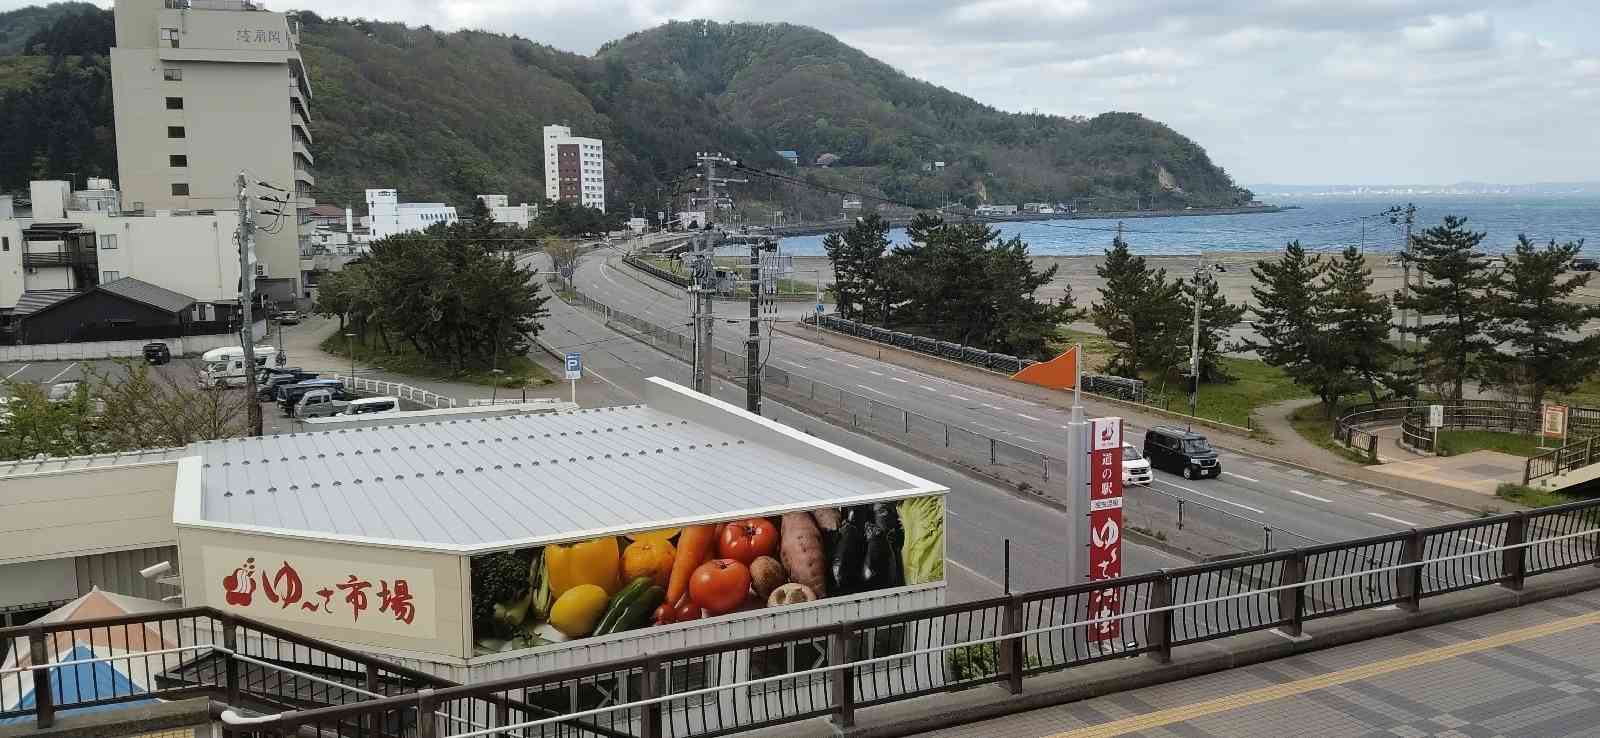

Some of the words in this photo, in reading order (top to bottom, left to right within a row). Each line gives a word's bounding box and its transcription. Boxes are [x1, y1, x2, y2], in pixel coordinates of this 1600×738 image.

[567, 359, 578, 371] P
[1101, 452, 1113, 495] 道の駅
